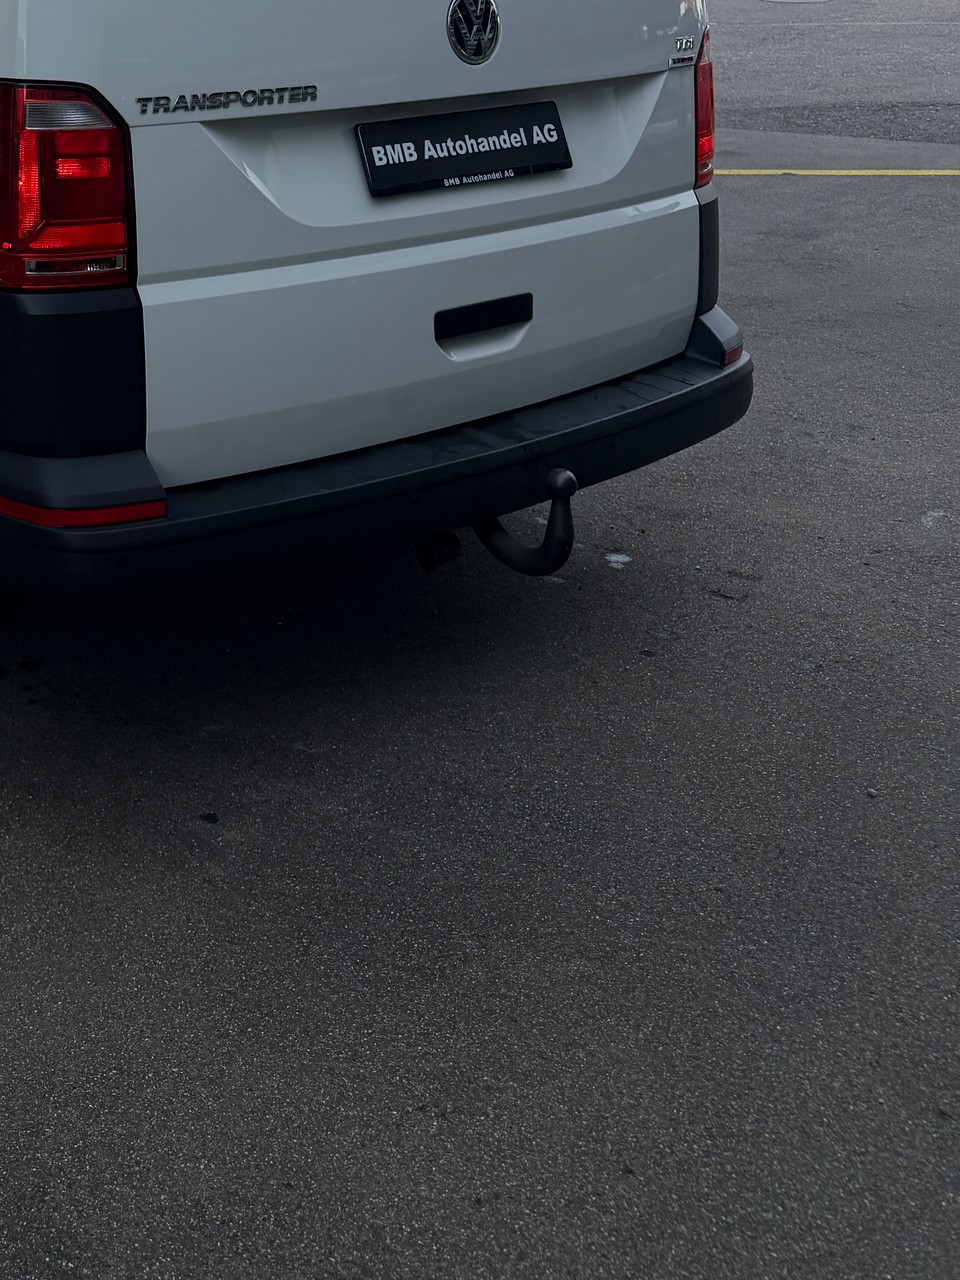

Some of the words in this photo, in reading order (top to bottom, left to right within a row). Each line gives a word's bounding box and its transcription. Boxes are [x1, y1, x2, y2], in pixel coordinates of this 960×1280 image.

[135, 85, 318, 115] TRANSPORTER
[371, 141, 418, 167] BMB
[424, 127, 528, 160] Autohandel
[532, 123, 559, 145] AG
[444, 176, 461, 187] BMB
[462, 171, 503, 184] Autohandel
[503, 169, 515, 178] AG
